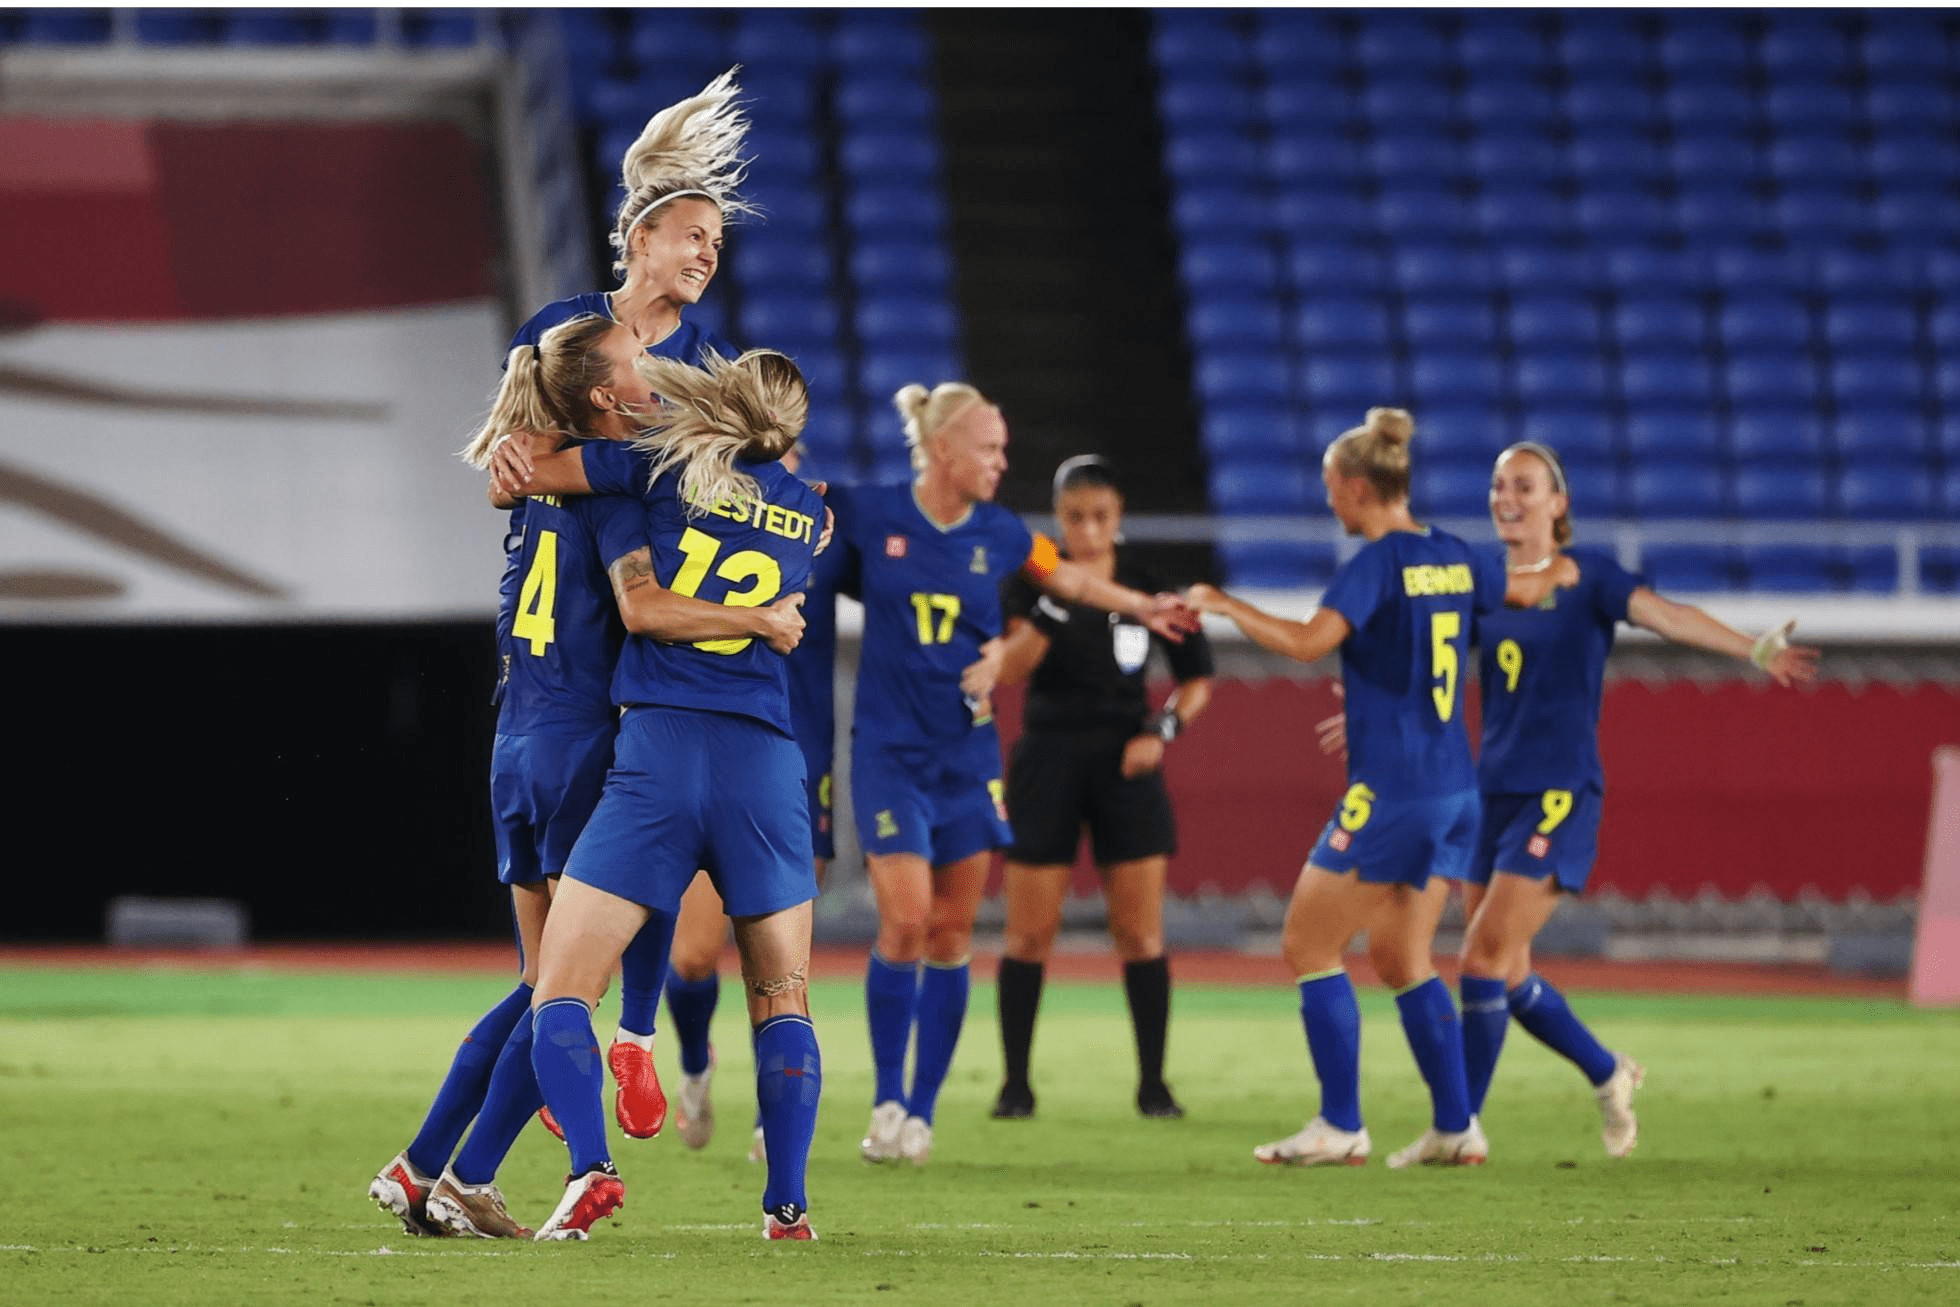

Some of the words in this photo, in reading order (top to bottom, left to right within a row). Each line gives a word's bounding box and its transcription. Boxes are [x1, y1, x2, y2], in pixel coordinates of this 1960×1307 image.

[684, 481, 814, 545] IESTEDT
[512, 530, 557, 657] 4
[670, 526, 782, 656] 13
[911, 592, 961, 645] 17
[1431, 611, 1460, 722] 5
[1496, 638, 1523, 692] 9
[1538, 789, 1573, 834] 9
